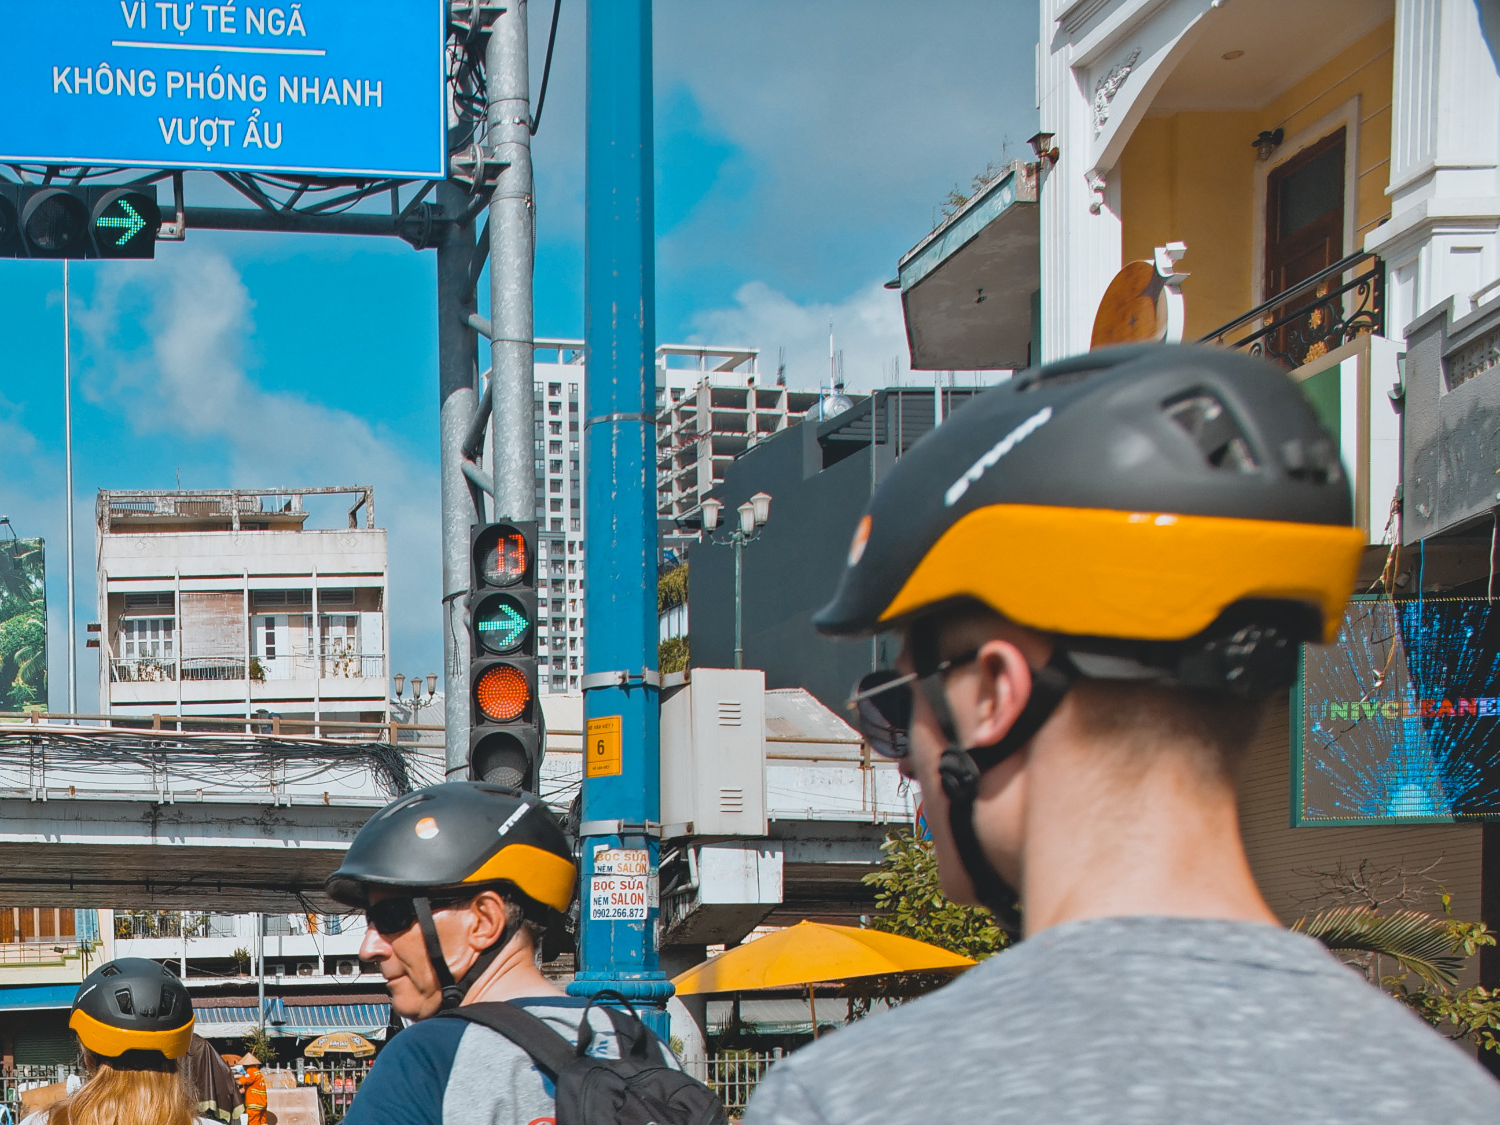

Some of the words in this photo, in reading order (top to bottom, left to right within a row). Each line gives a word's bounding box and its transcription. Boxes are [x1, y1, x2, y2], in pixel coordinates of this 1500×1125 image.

[155, 1, 194, 37] TỰ
[201, 0, 237, 34] TÉ
[246, 3, 307, 37] NGÃ
[52, 63, 157, 99] KHÔNG
[166, 65, 268, 103] PHÓNG
[279, 75, 383, 108] NHANH
[158, 116, 235, 152] VƯỢT
[244, 107, 283, 149] ẨU
[597, 739, 605, 756] 6
[617, 863, 647, 873] SALON
[593, 880, 615, 892] BỌC
[620, 876, 644, 891] SỬA
[611, 892, 644, 906] SALON
[593, 908, 644, 919] 0902.266.872
